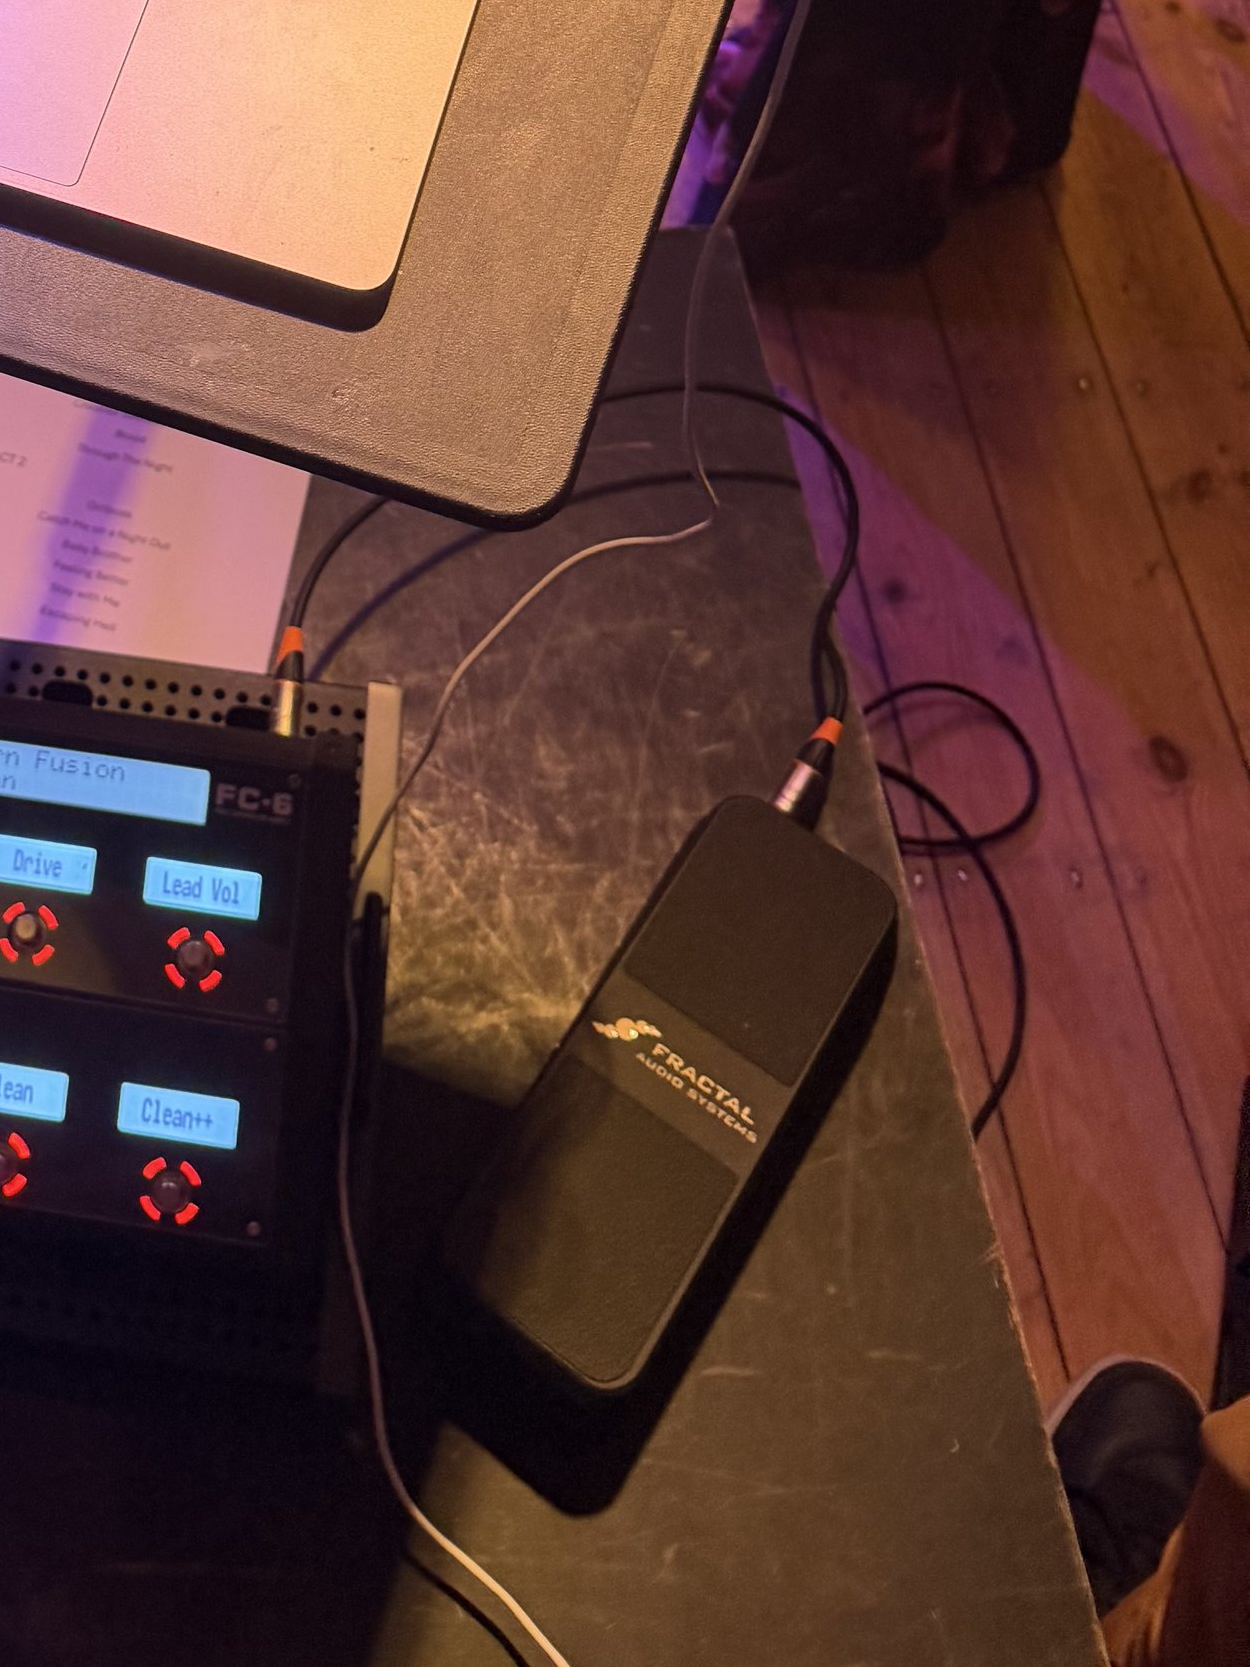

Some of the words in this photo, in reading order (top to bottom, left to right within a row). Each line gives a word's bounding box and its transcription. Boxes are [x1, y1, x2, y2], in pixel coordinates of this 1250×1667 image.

[16, 455, 28, 468] 2
[117, 530, 147, 544] Night
[149, 537, 172, 551] Out
[35, 750, 126, 783] Fusion
[12, 849, 63, 879] Drive
[162, 873, 202, 901] Lead
[211, 880, 240, 907] Vol
[636, 1052, 684, 1089] AUDIO
[686, 1088, 758, 1143] SYSTEMS
[652, 1043, 755, 1125] FRACTAL
[141, 1098, 214, 1131] Clean++
